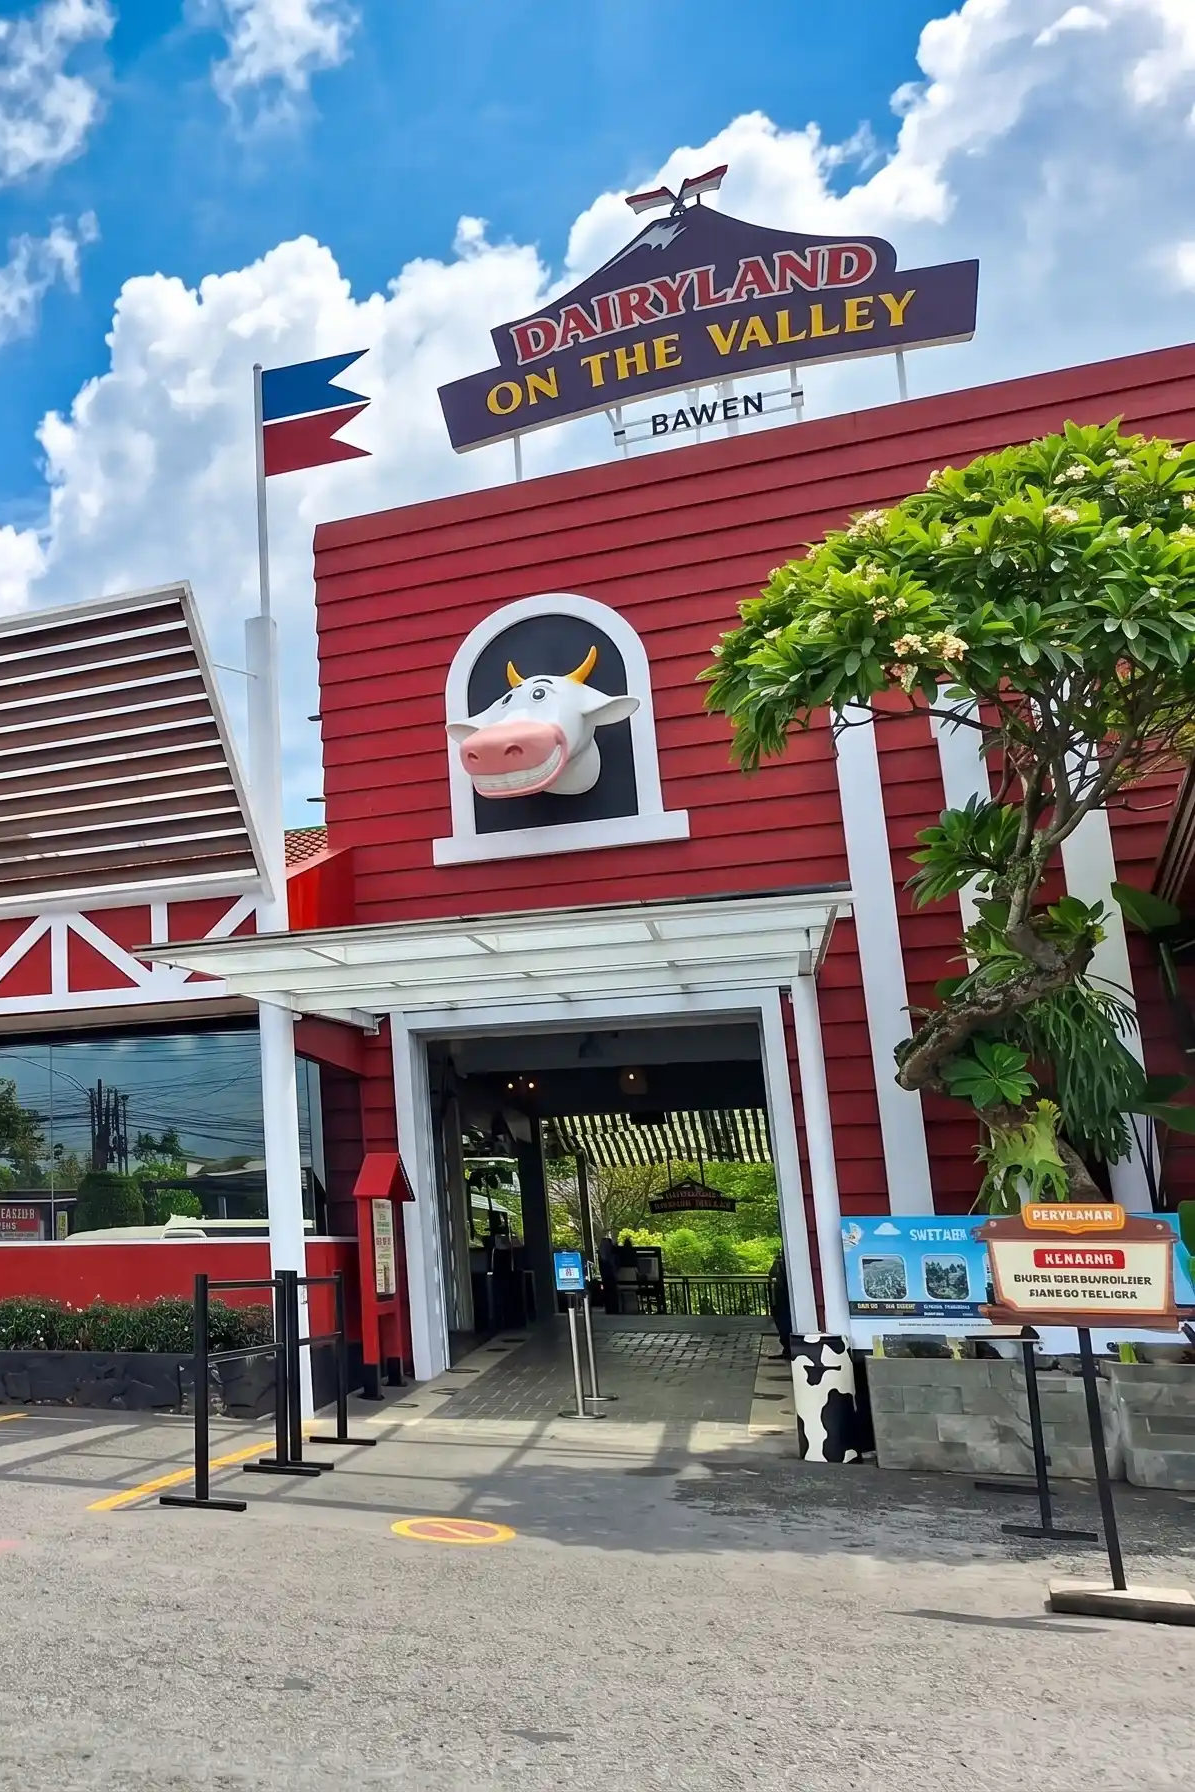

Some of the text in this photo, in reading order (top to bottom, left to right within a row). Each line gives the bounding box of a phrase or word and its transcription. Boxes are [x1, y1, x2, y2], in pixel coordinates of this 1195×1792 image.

[485, 289, 917, 417] ON THE VALLEY
[509, 241, 878, 366] DAIRYLAND
[650, 391, 765, 437] BAWEN
